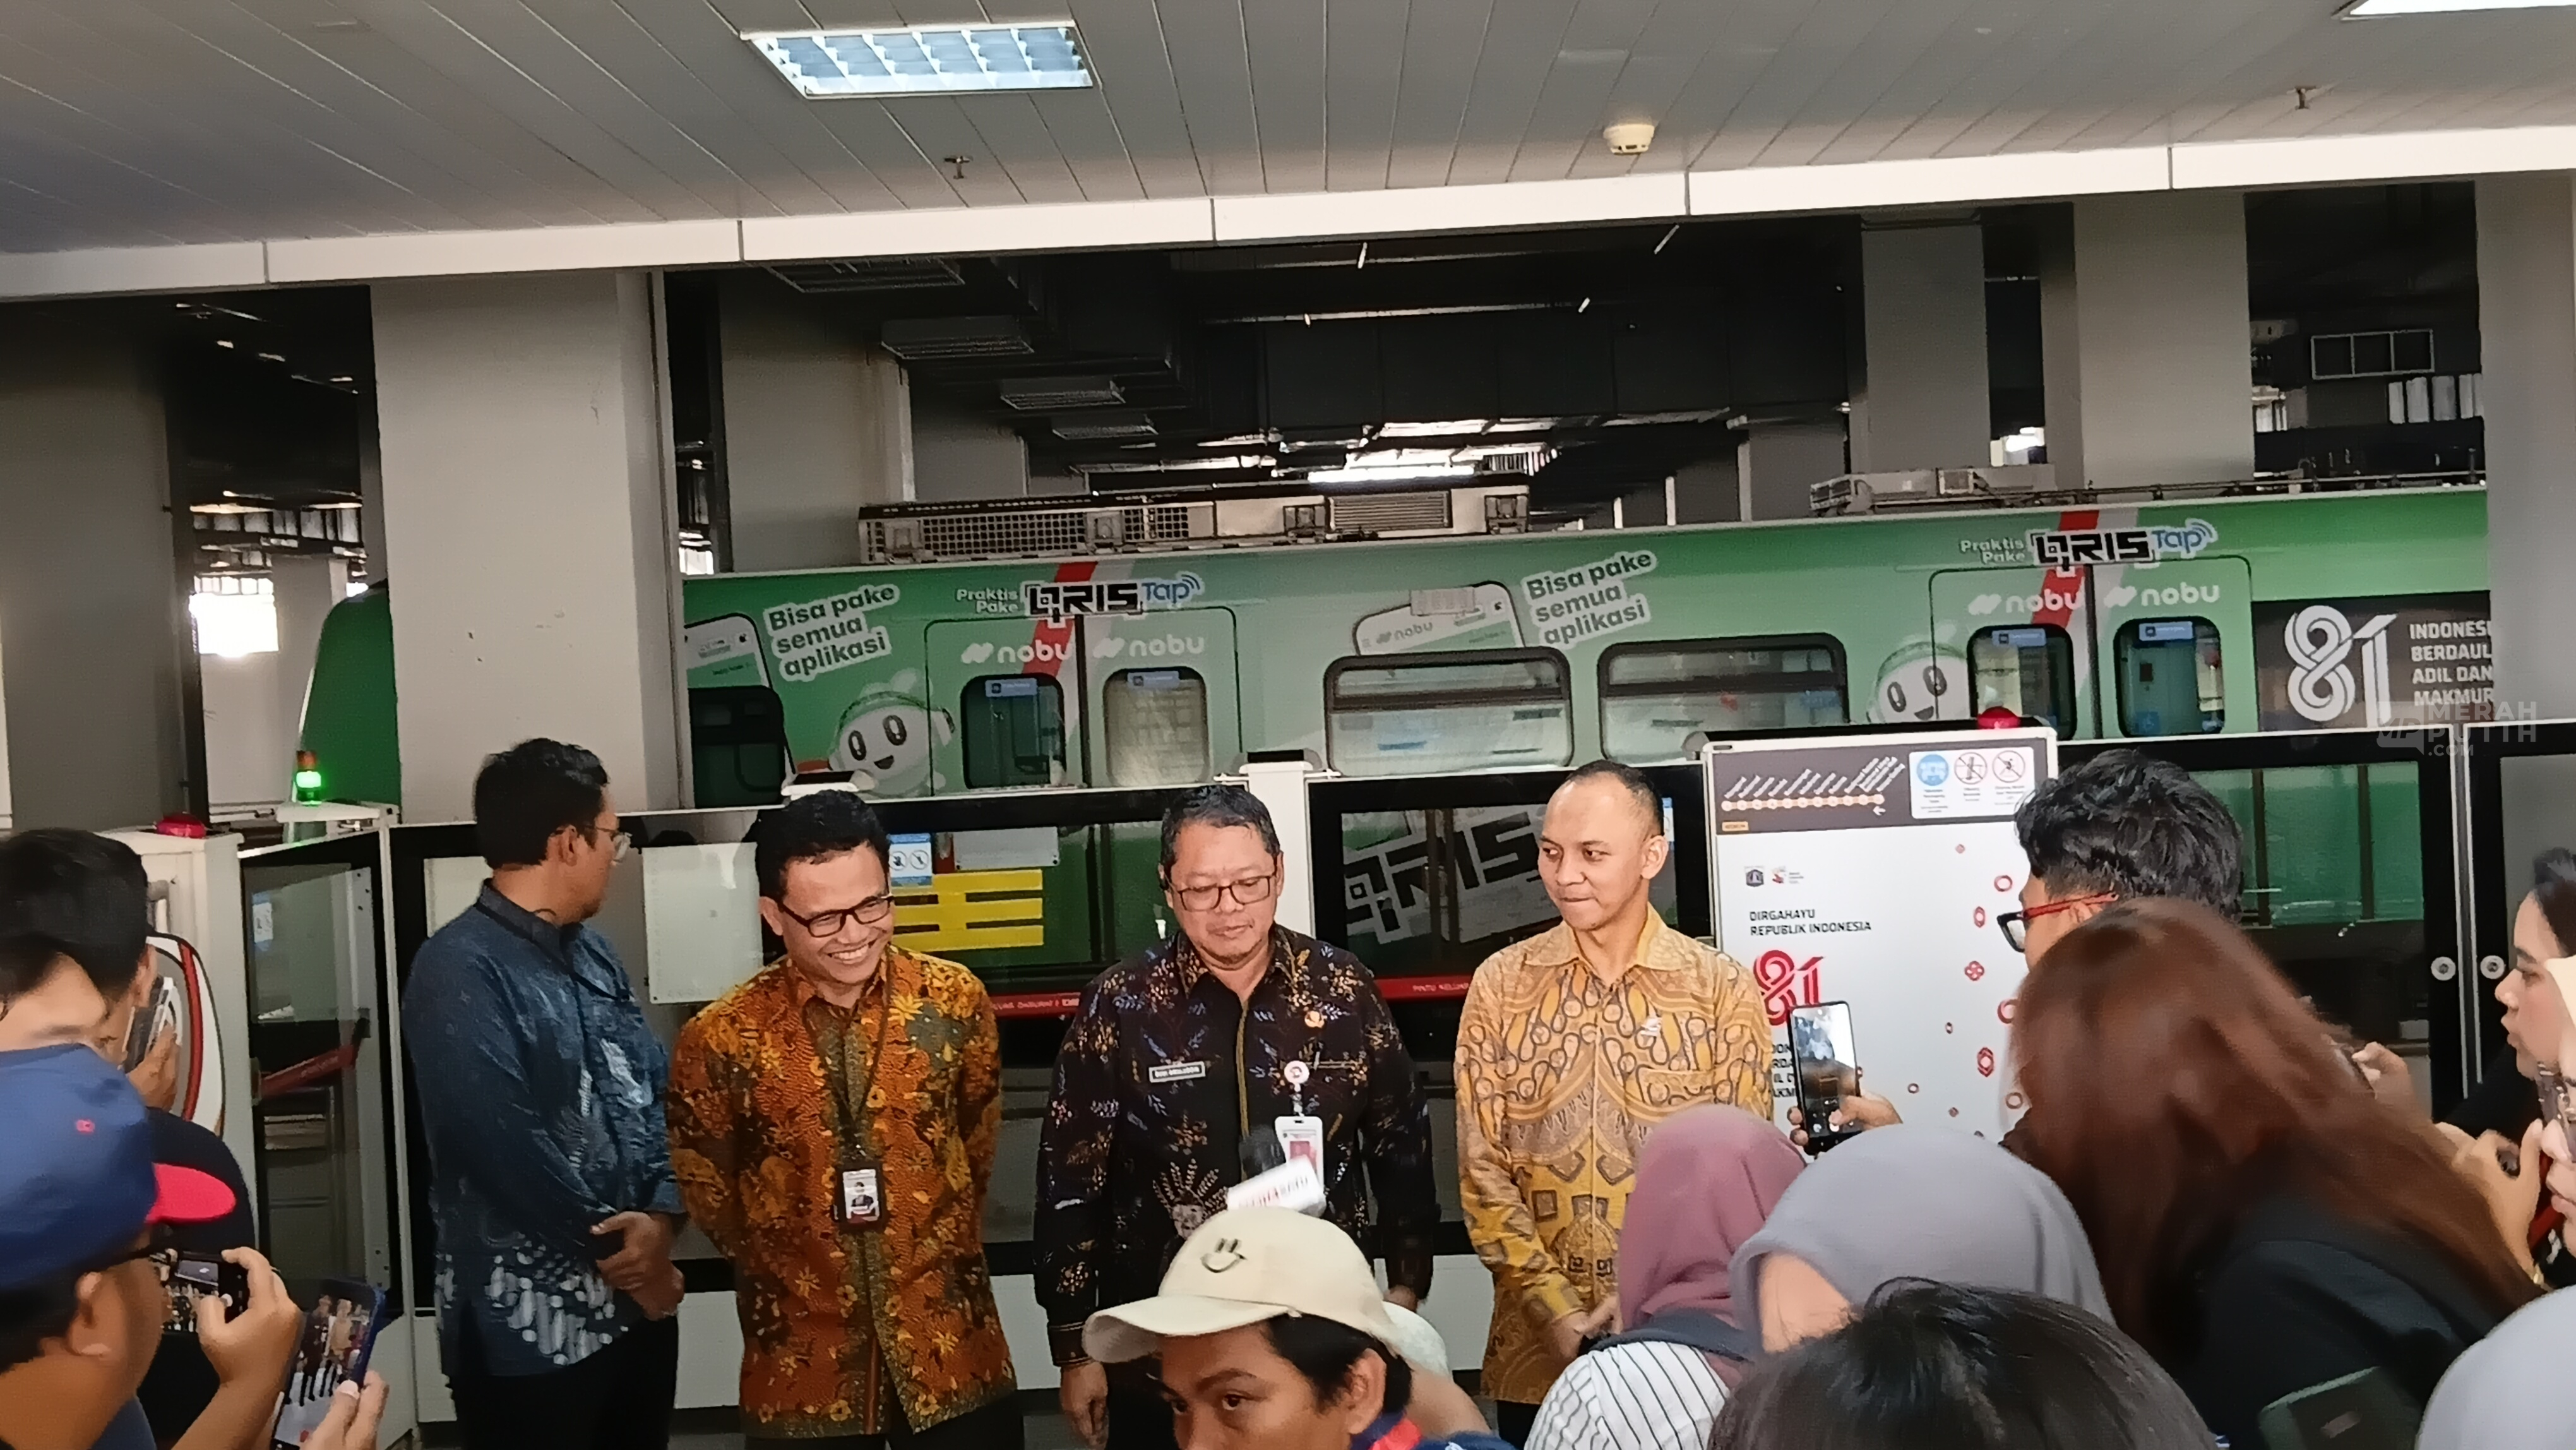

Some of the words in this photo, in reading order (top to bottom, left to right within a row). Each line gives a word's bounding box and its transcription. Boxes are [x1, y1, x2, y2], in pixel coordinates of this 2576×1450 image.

[1960, 537, 2024, 553] Praktis
[2034, 530, 2151, 572] QRIS
[2150, 529, 2202, 553] Tap
[1983, 551, 2025, 564] Pake
[1527, 572, 1585, 600] Bisa
[1588, 554, 1652, 586] pake
[957, 587, 1018, 602] Praktis
[976, 600, 1018, 613] Pake
[1029, 582, 1138, 623] QRIS
[1142, 581, 1190, 604] Tap
[1535, 585, 1622, 622] semua
[2005, 589, 2084, 614] nobu
[2141, 582, 2220, 607] nobu
[768, 604, 827, 631] Bisa
[831, 587, 895, 618] pake
[1544, 599, 1645, 644] aplikasi
[2409, 620, 2492, 639] INDONESI
[777, 618, 862, 654] semua
[1130, 633, 1205, 657] nobu
[784, 632, 885, 676] aplikasi
[997, 640, 1072, 664] nobu
[2411, 643, 2493, 662] BERDAUL
[2284, 605, 2398, 728] 81
[2412, 667, 2453, 685] ADIL
[2457, 665, 2493, 682] DAN
[2414, 686, 2494, 706] MAKMUR
[1750, 909, 1815, 921] DIRGAHAYU
[1750, 924, 1806, 935] REPUBLIK
[1809, 921, 1872, 933] INDONESIA
